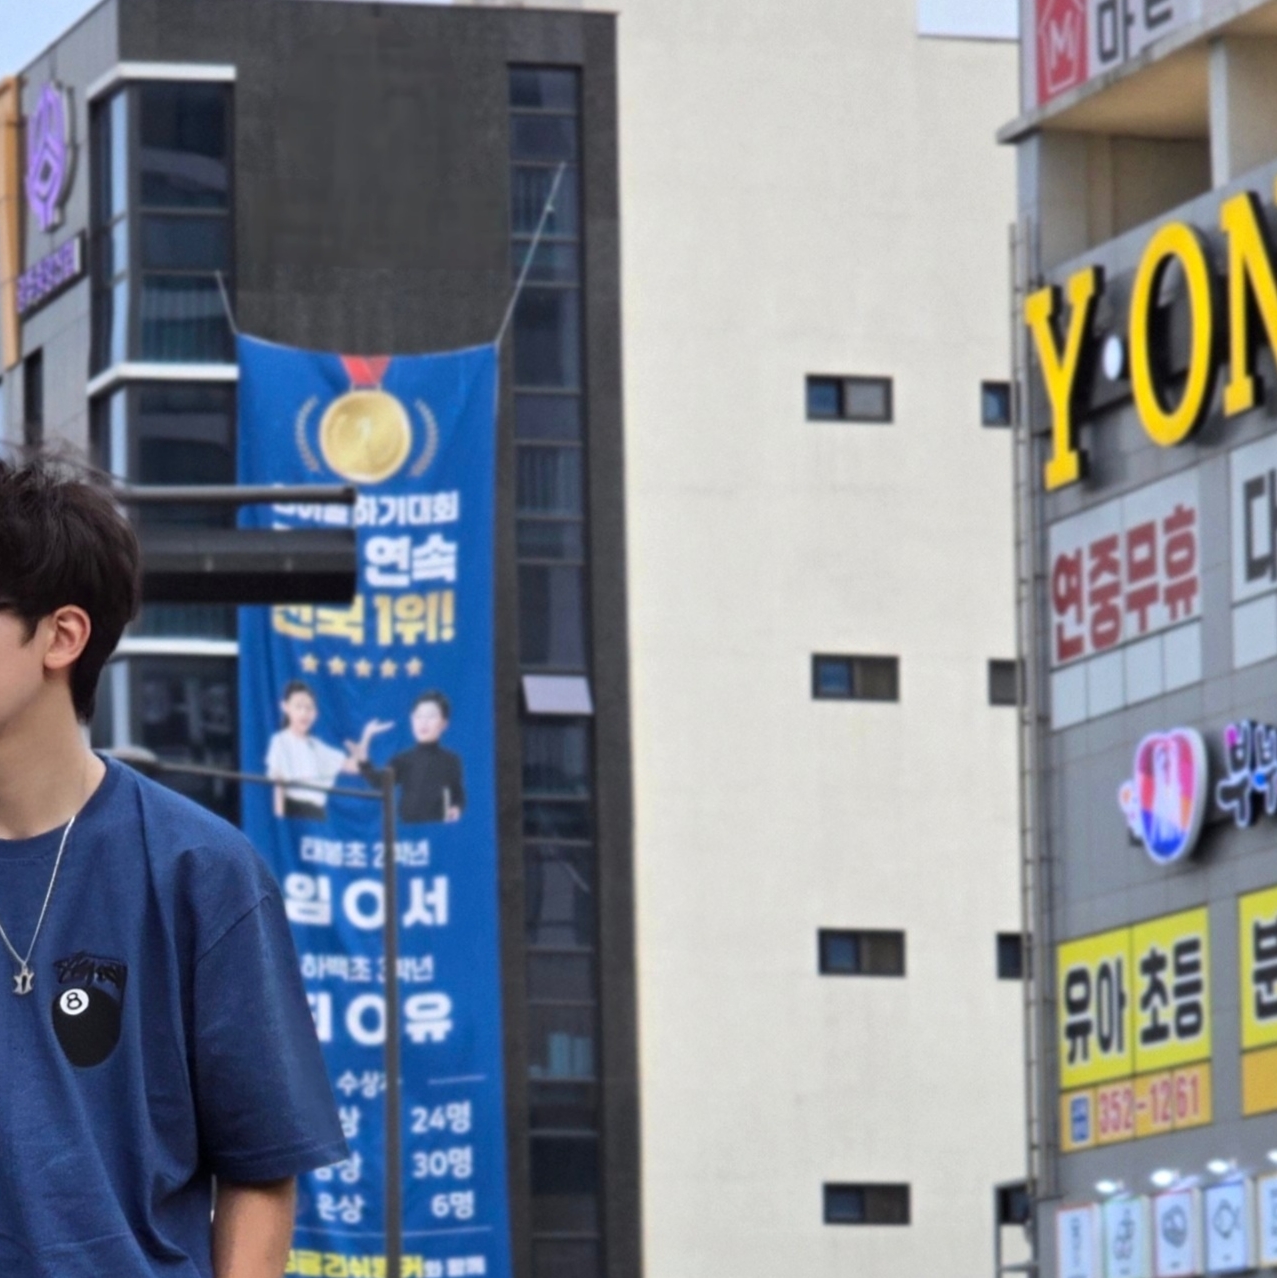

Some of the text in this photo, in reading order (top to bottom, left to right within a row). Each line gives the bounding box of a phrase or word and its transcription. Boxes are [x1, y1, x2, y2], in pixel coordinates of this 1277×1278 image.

[364, 532, 458, 588] 연속
[1051, 503, 1199, 662] 연중무휴
[372, 590, 456, 646] 1위!
[66, 991, 83, 1011] 8
[410, 1100, 472, 1135] 24명
[412, 1146, 473, 1179] 30명
[430, 1189, 475, 1220] 6명
